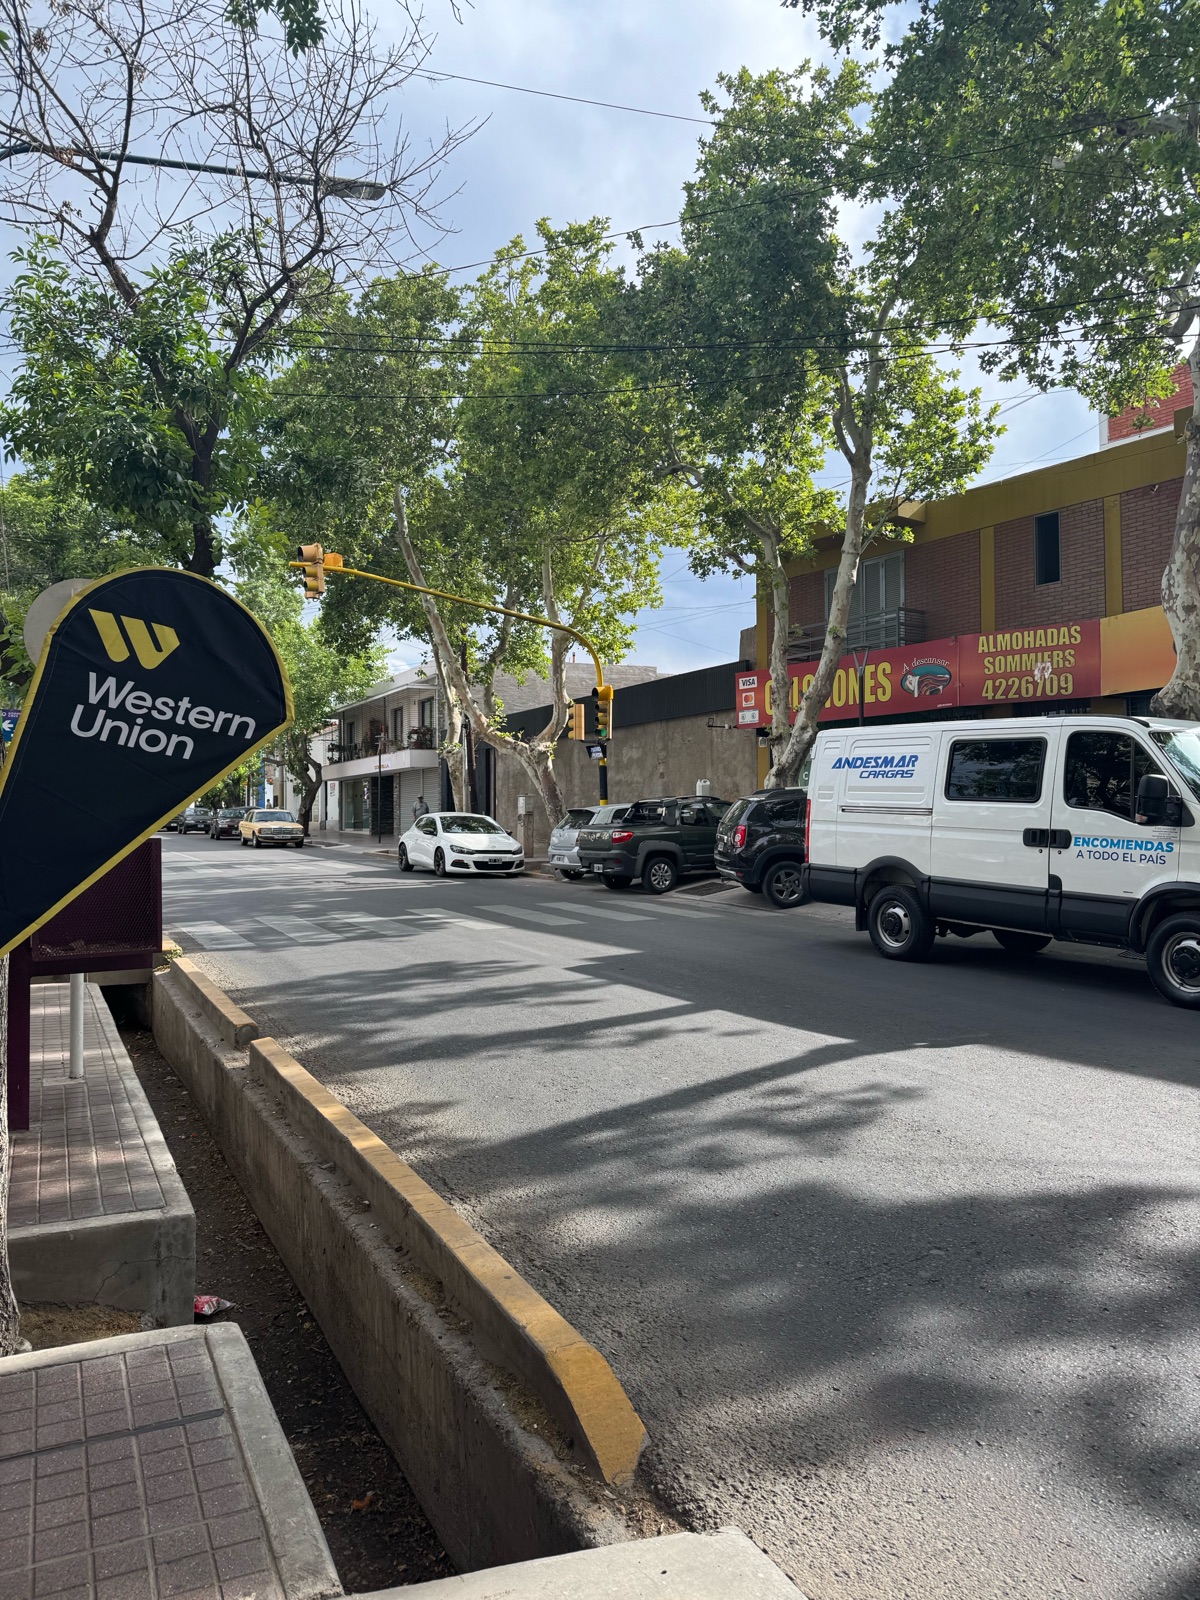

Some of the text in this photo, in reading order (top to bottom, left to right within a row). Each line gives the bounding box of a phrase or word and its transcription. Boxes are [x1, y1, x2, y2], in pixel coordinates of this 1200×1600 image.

[978, 625, 1081, 653] ALMOHADAS
[902, 657, 950, 675] A descansar
[984, 649, 1076, 675] SOMMIERS
[741, 678, 756, 687] VISA
[88, 671, 256, 739] Western
[70, 704, 194, 760] Union
[831, 754, 919, 769] ANDESMAR
[859, 769, 915, 779] CARGAS
[1073, 836, 1174, 853] ENCOMIENDAS
[1076, 850, 1166, 865] A TODO EL PAÍS
